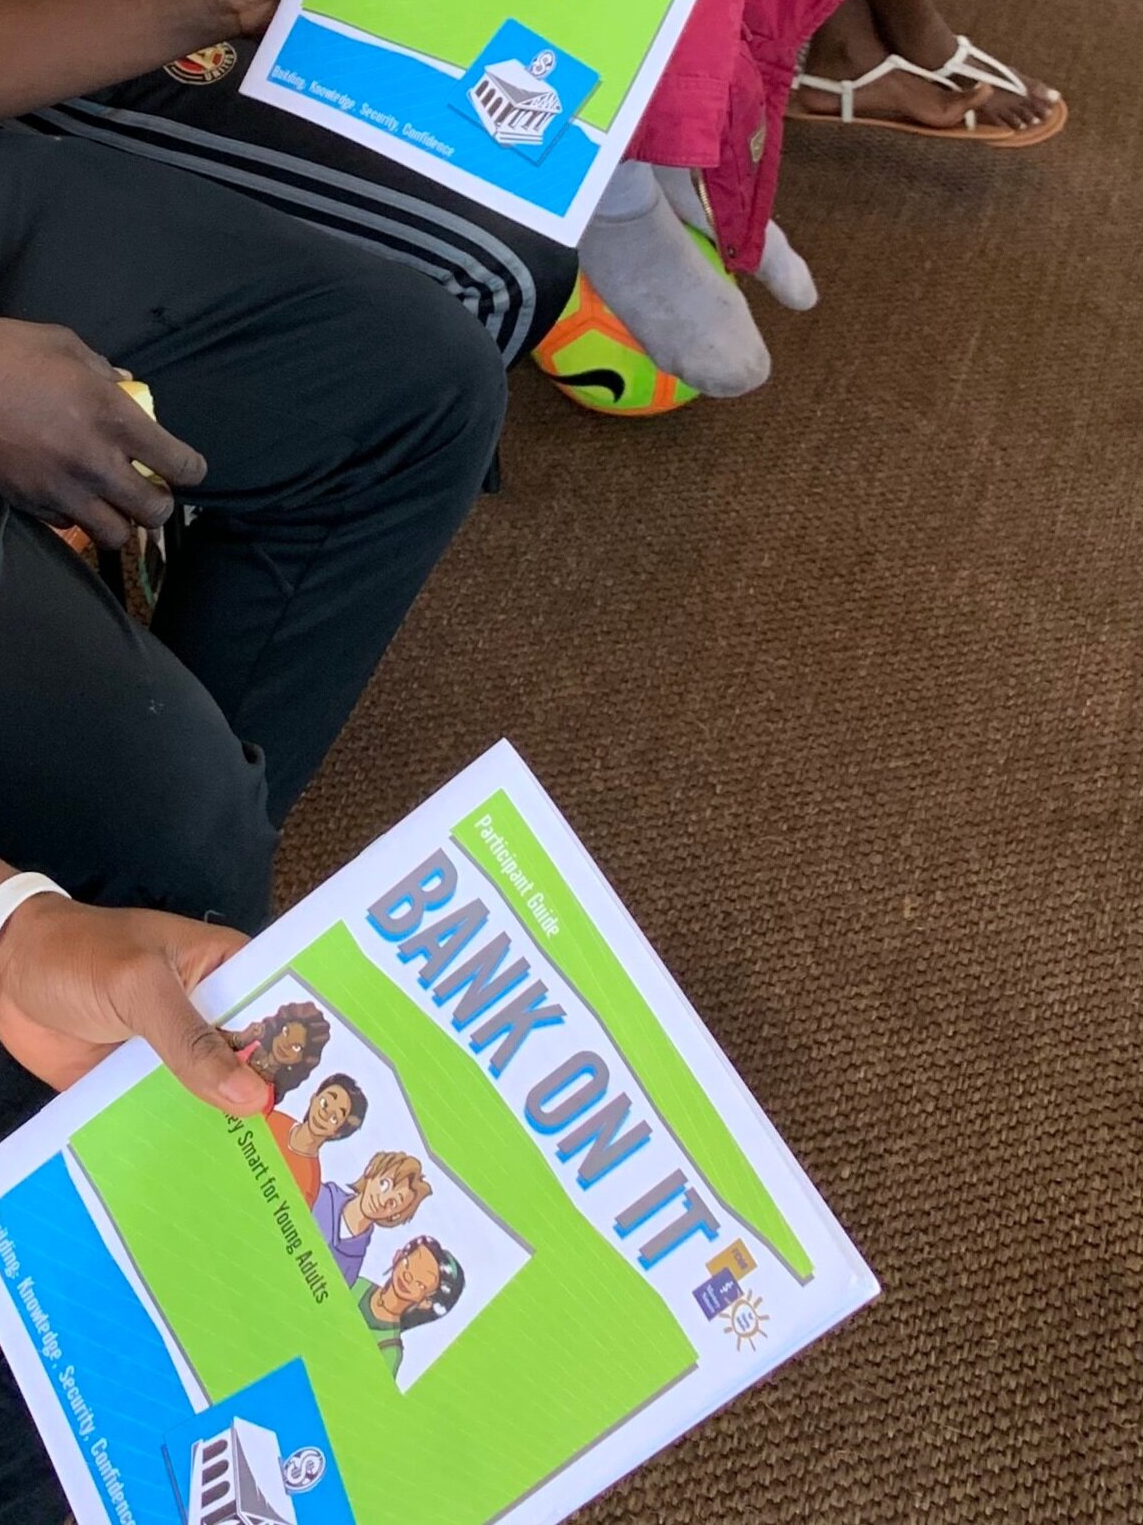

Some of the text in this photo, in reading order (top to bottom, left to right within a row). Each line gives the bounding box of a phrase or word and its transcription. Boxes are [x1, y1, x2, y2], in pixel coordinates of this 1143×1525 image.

[401, 122, 456, 157] Confidence
[474, 814, 560, 939] Participant Guide
[365, 847, 722, 1272] BANK ON IT
[237, 1130, 329, 1305] Smart for Young Adults
[59, 1365, 96, 1442] Security,
